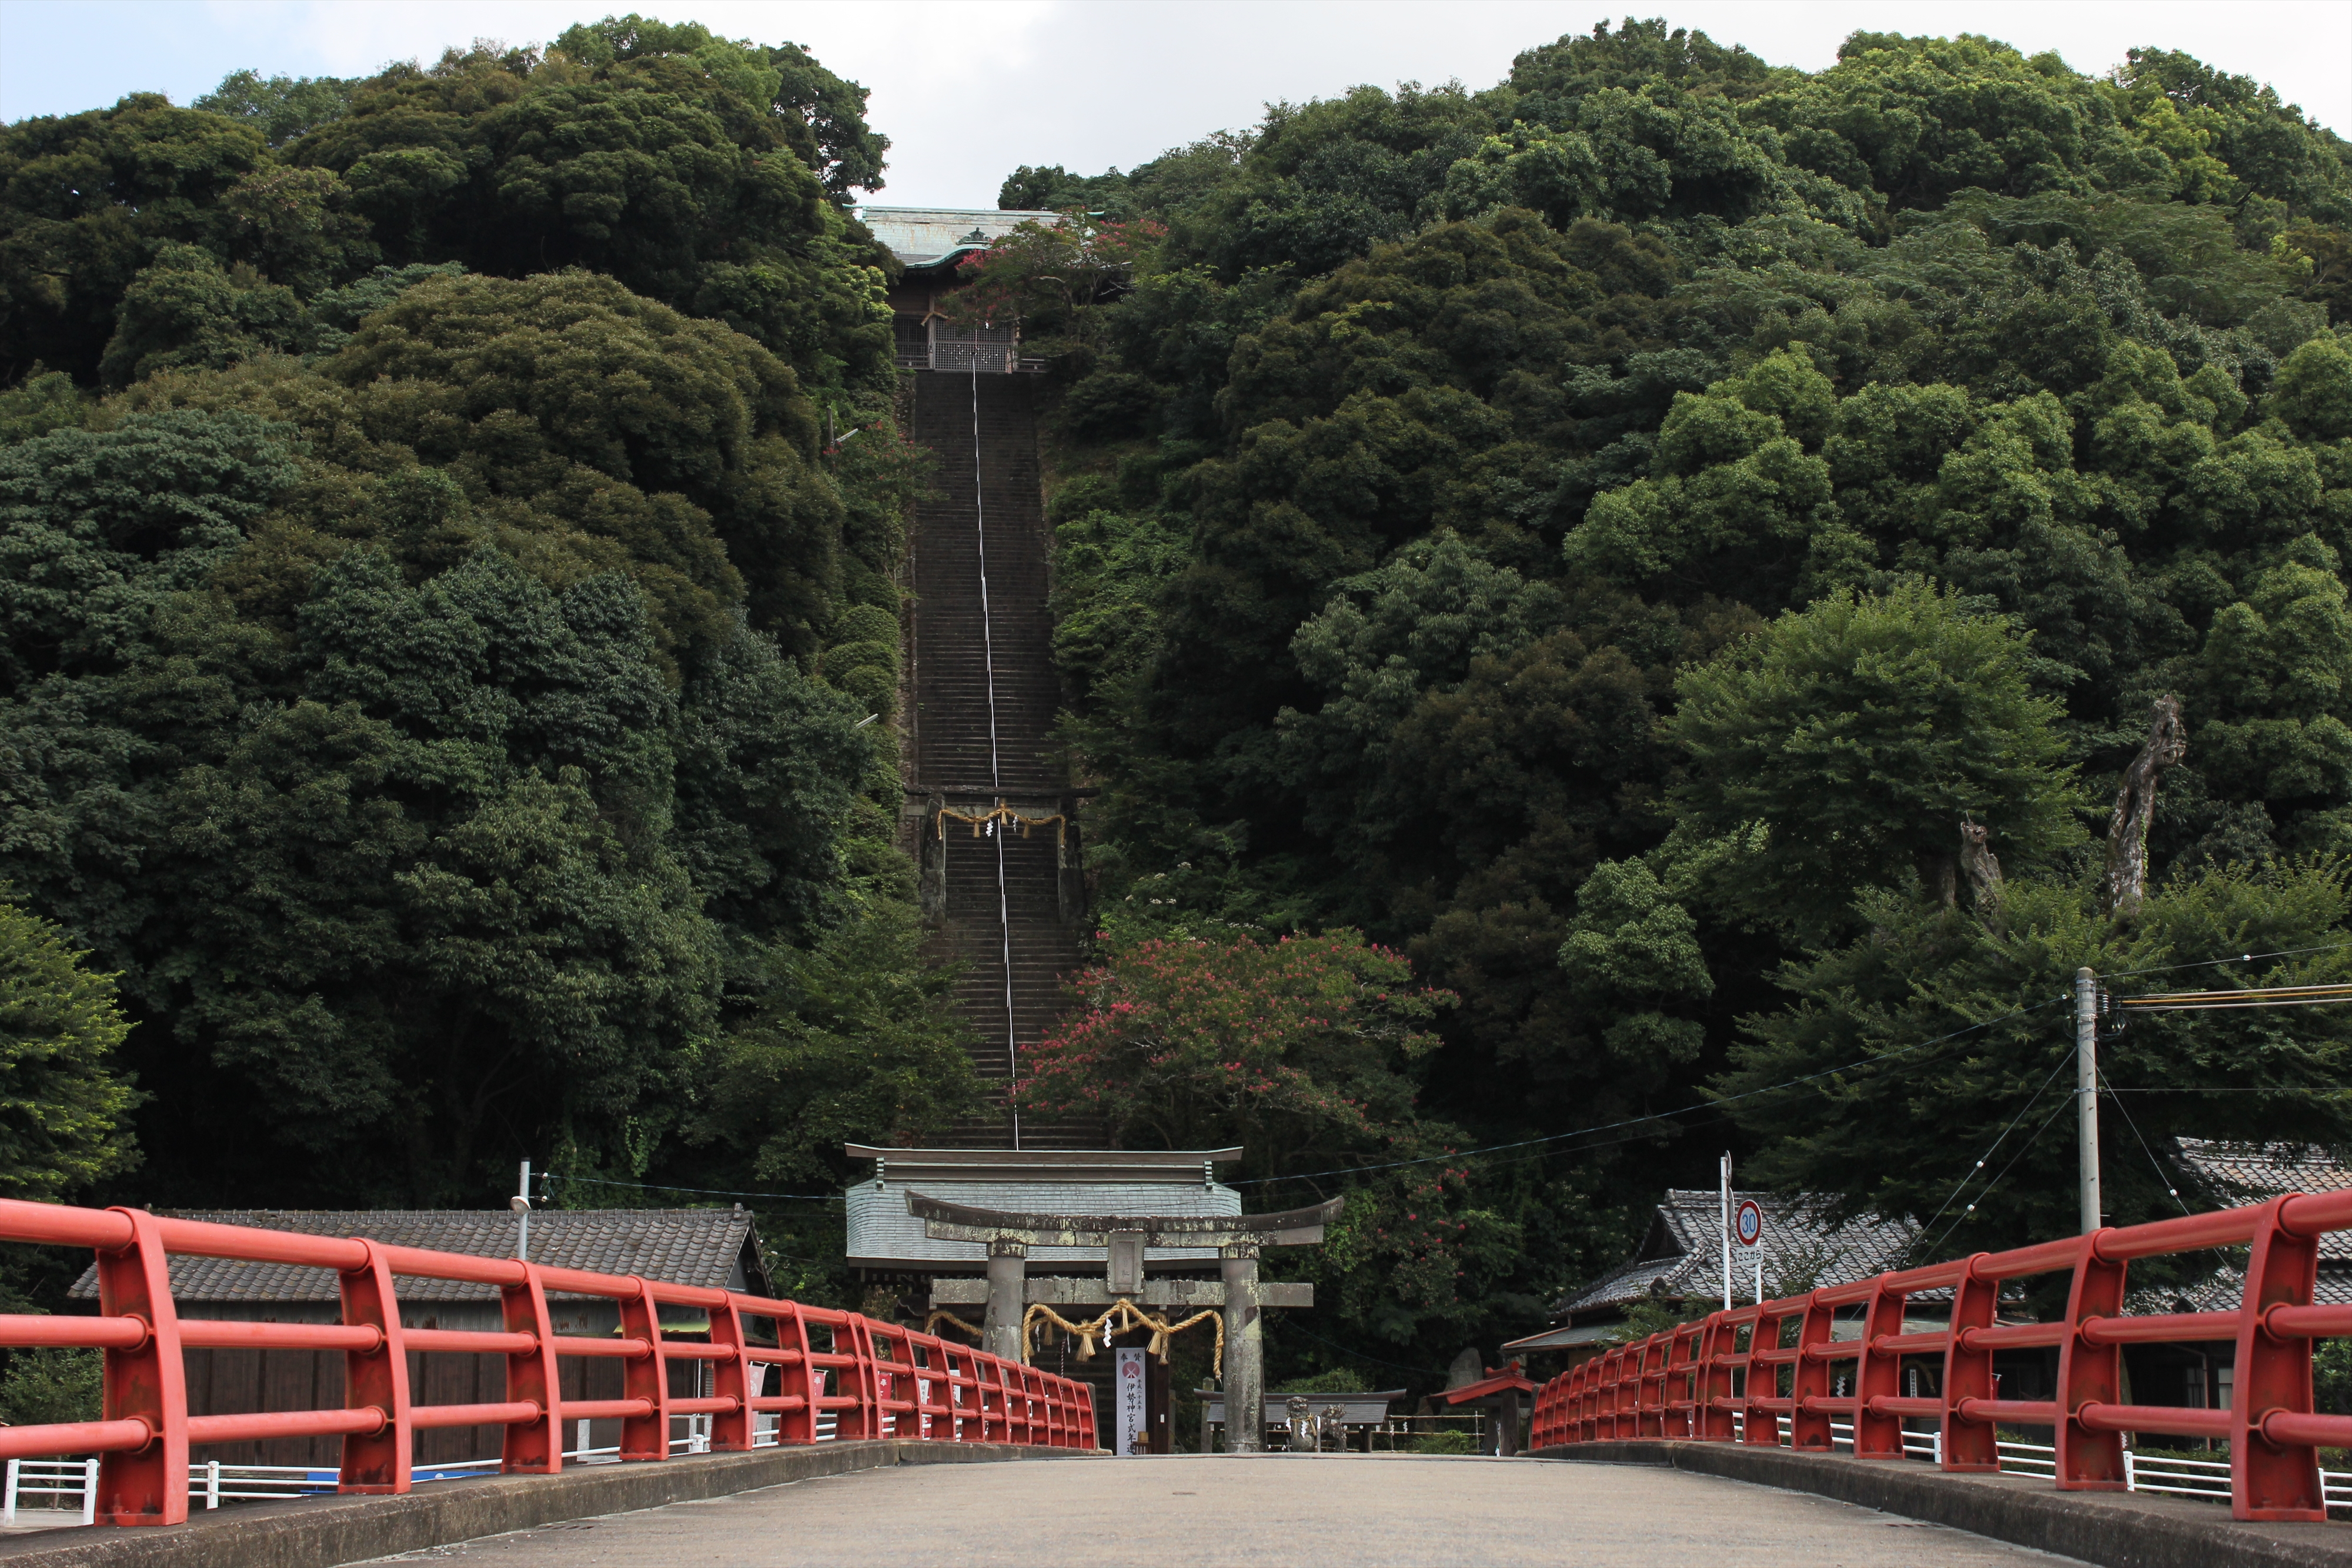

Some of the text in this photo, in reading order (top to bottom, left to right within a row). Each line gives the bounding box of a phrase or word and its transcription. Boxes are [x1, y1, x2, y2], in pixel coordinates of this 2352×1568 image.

[1742, 1213, 1756, 1233] 30
[1738, 1250, 1762, 1261] ここから
